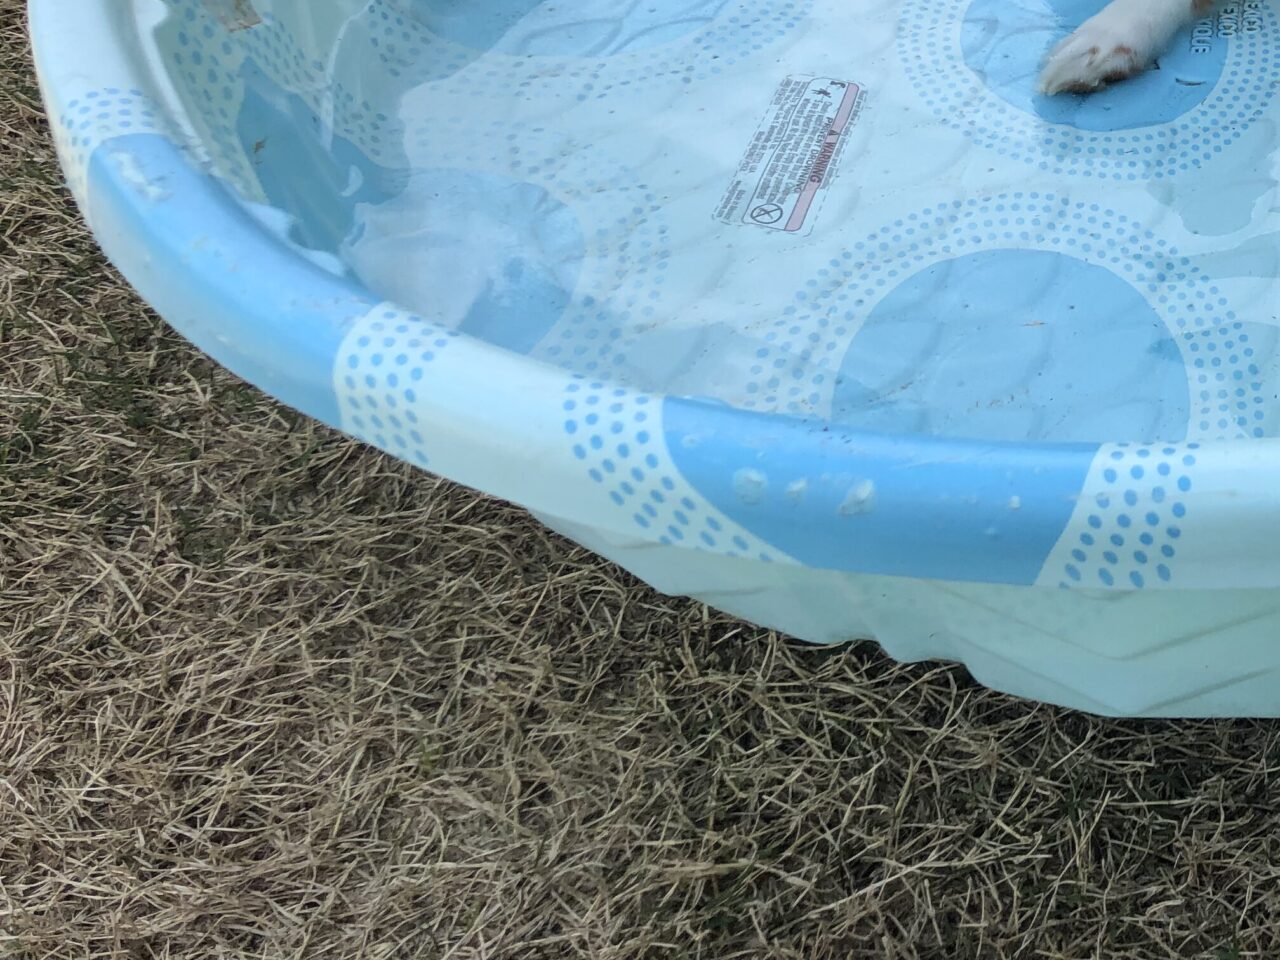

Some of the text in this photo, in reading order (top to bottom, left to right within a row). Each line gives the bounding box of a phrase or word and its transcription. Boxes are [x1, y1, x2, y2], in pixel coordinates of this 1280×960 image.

[811, 116, 834, 149] PREVENT
[793, 147, 820, 194] DROWNING
[810, 141, 837, 184] WARNING
